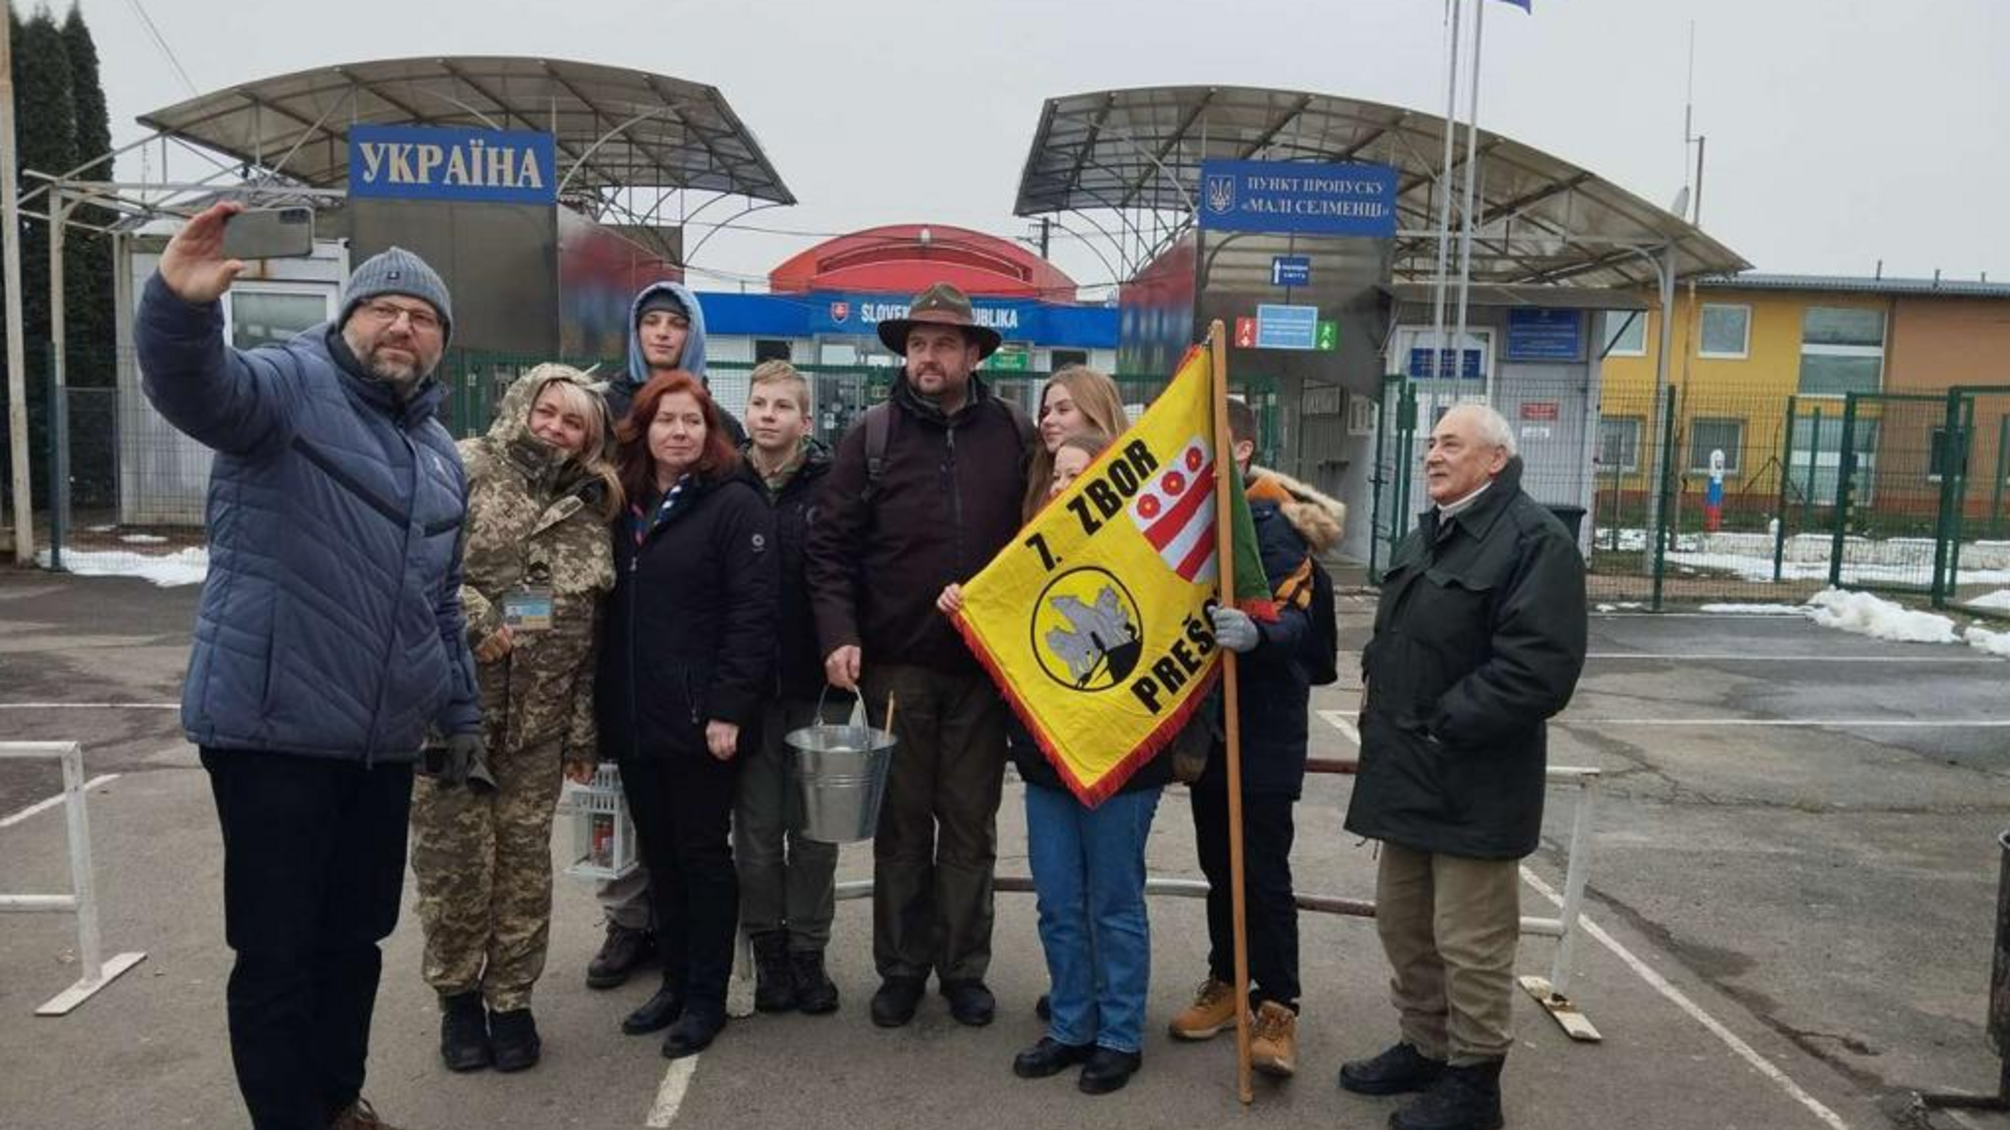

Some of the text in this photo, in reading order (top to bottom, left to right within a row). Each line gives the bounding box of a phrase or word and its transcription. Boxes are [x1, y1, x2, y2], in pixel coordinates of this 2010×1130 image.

[359, 138, 544, 189] УКРАЇНА
[1247, 177, 1383, 195] ПУНКТ ПРОПУСКУ
[861, 302, 1018, 329] SLOVEN UBLIKA
[1024, 438, 1159, 572] 7. ZBOR
